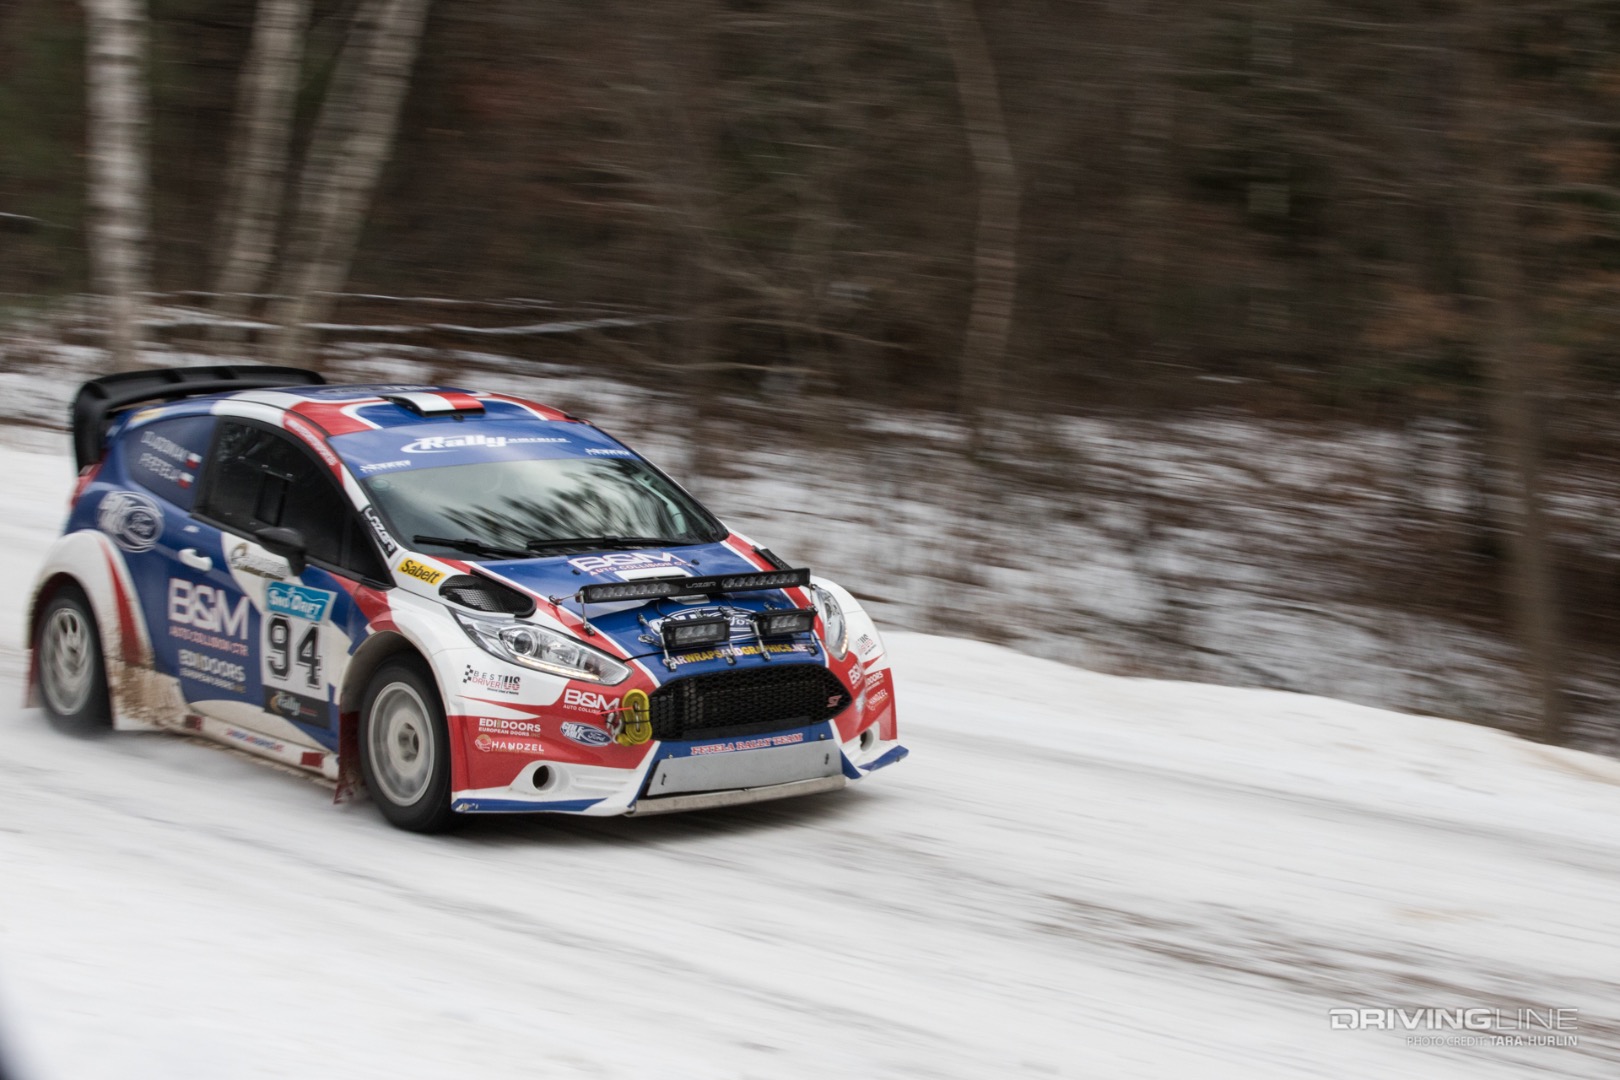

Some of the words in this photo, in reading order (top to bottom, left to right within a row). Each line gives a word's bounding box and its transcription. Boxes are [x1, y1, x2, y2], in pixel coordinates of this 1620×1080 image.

[411, 435, 506, 451] Rally
[400, 560, 440, 584] Sabelt
[590, 566, 617, 576] AUTO
[619, 561, 672, 570] COLLISION
[267, 614, 323, 690] 94
[472, 676, 500, 689] DRIVER
[473, 670, 502, 682] BEST
[564, 689, 620, 711] B&M
[479, 727, 509, 735] EUROPEAN
[501, 720, 541, 732] DOORS
[491, 741, 545, 752] HANDZEL
[736, 738, 772, 751] RALLY
[772, 732, 804, 746] TEAM
